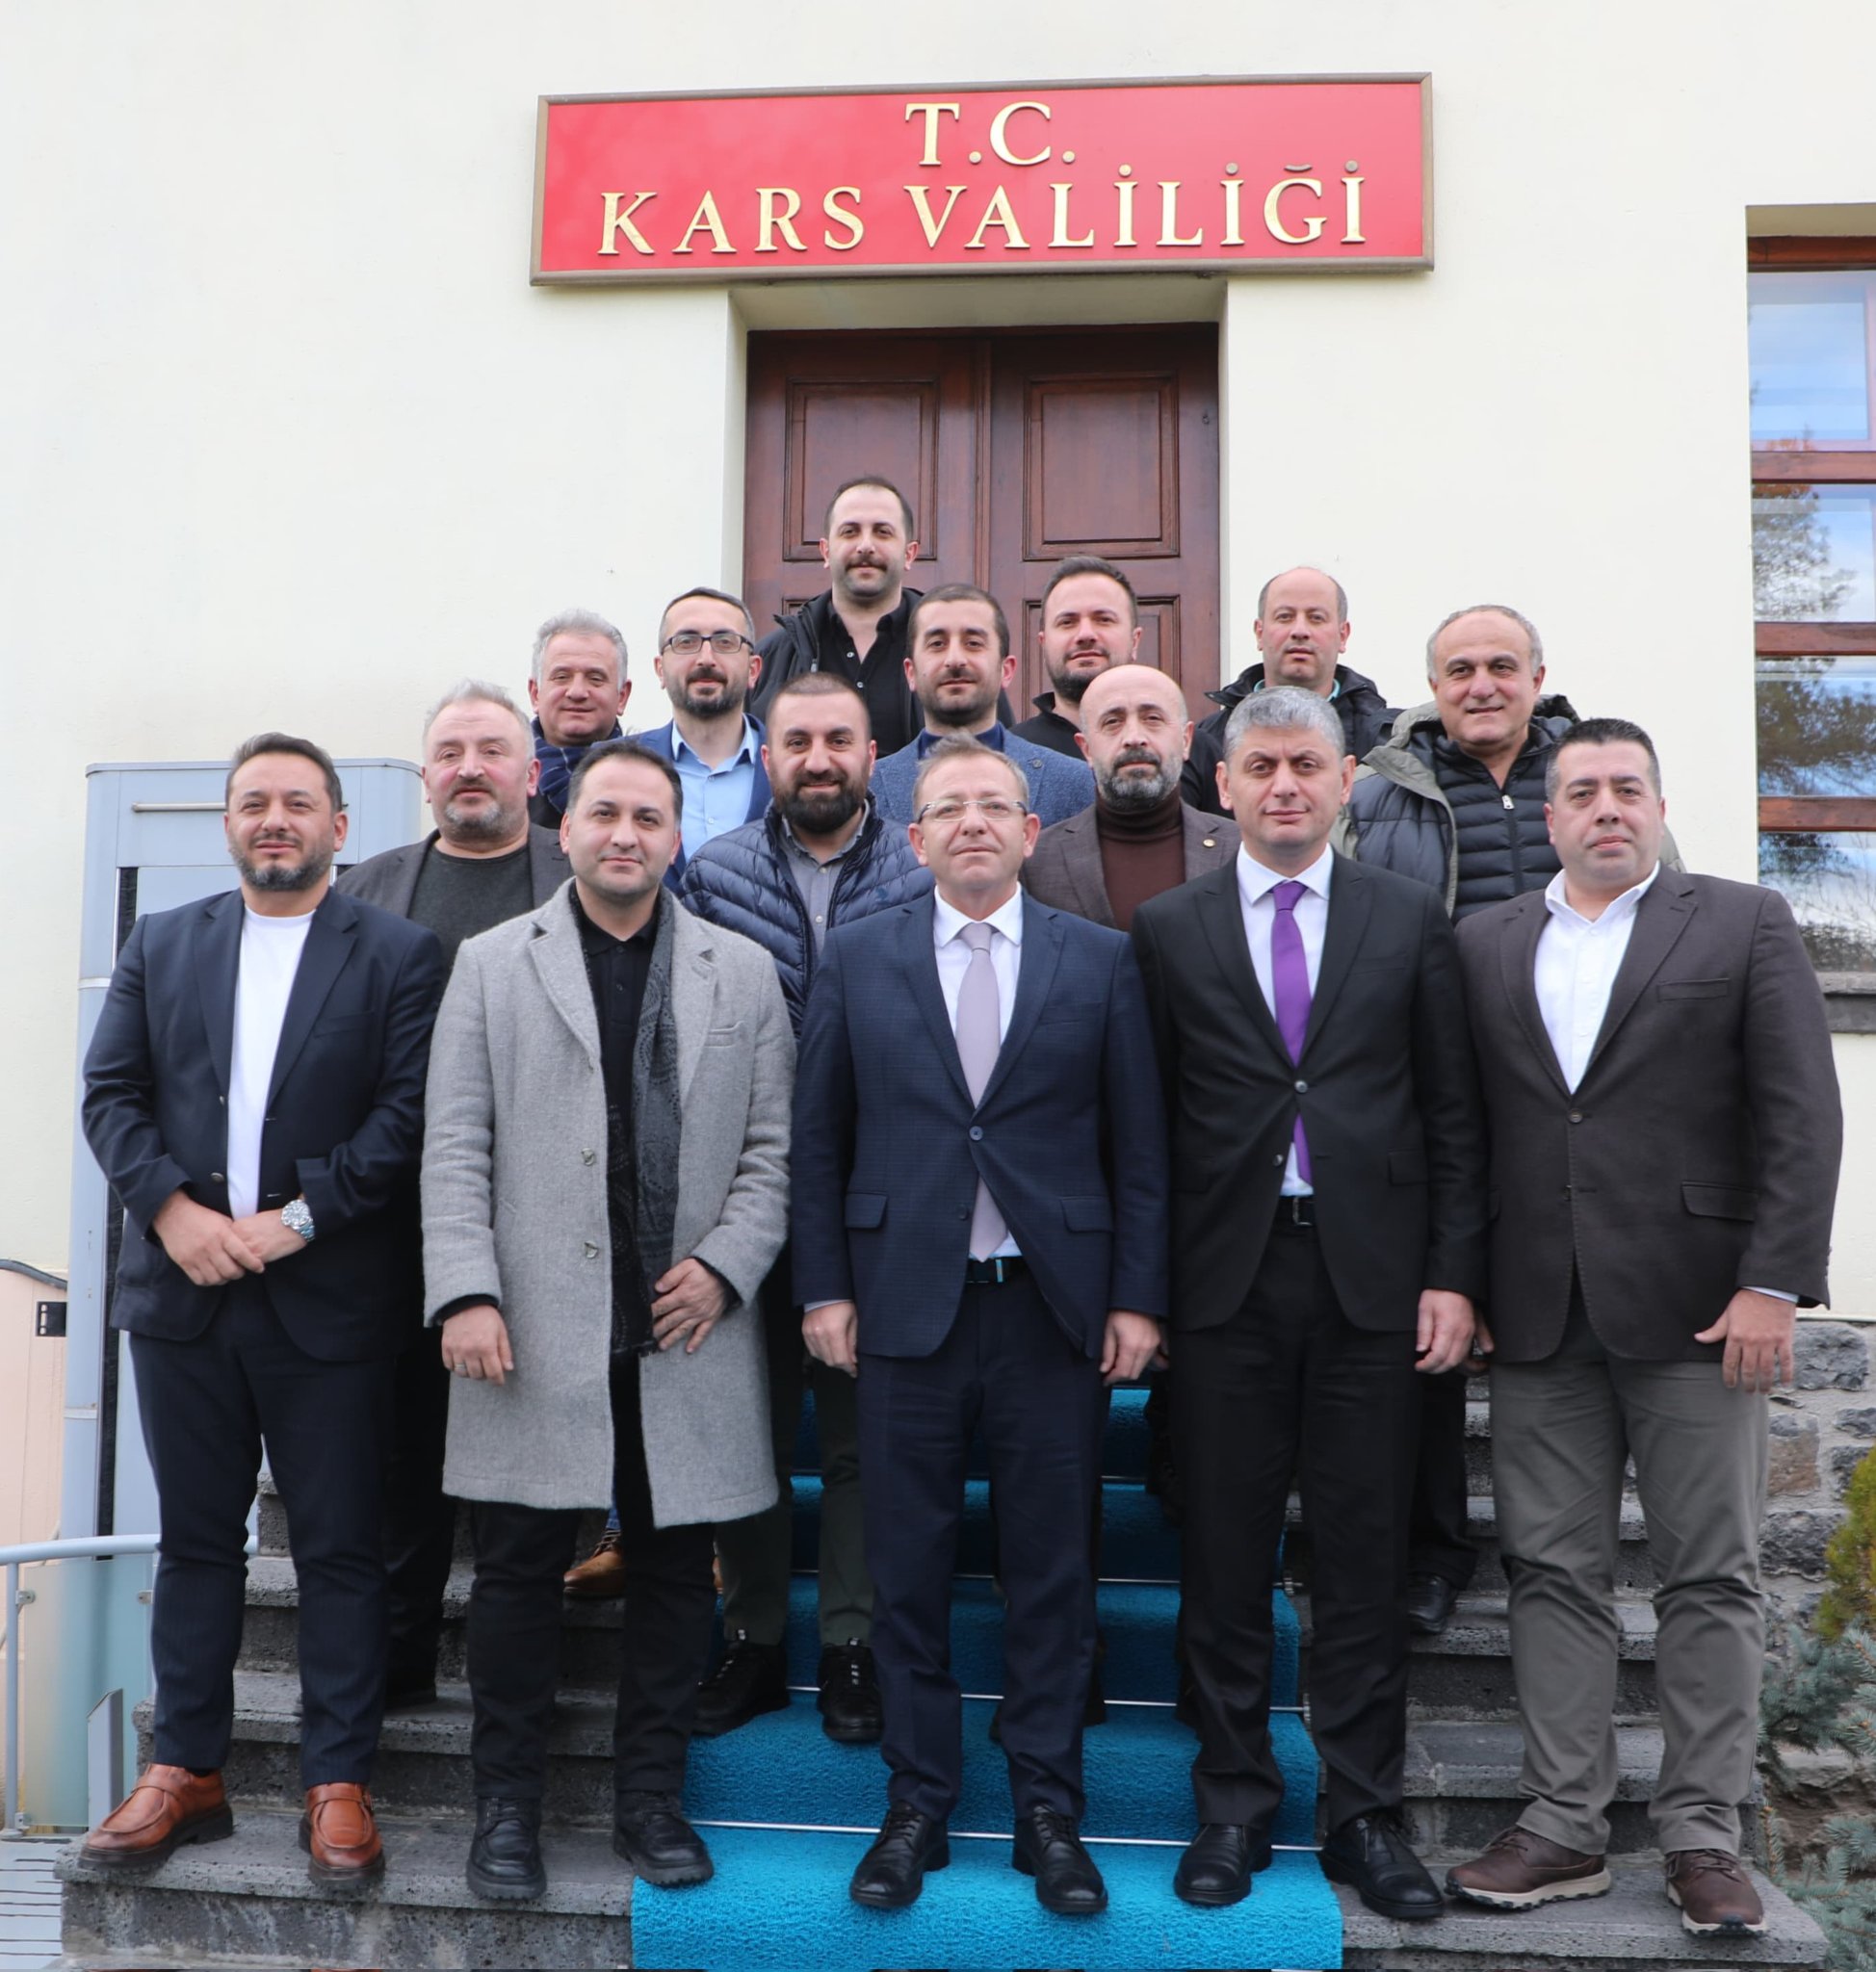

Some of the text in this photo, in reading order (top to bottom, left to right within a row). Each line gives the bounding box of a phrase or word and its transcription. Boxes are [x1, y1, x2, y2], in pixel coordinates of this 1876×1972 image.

[904, 100, 1077, 166] T.C.
[597, 159, 1367, 254] KARS VALİLİĞİ
